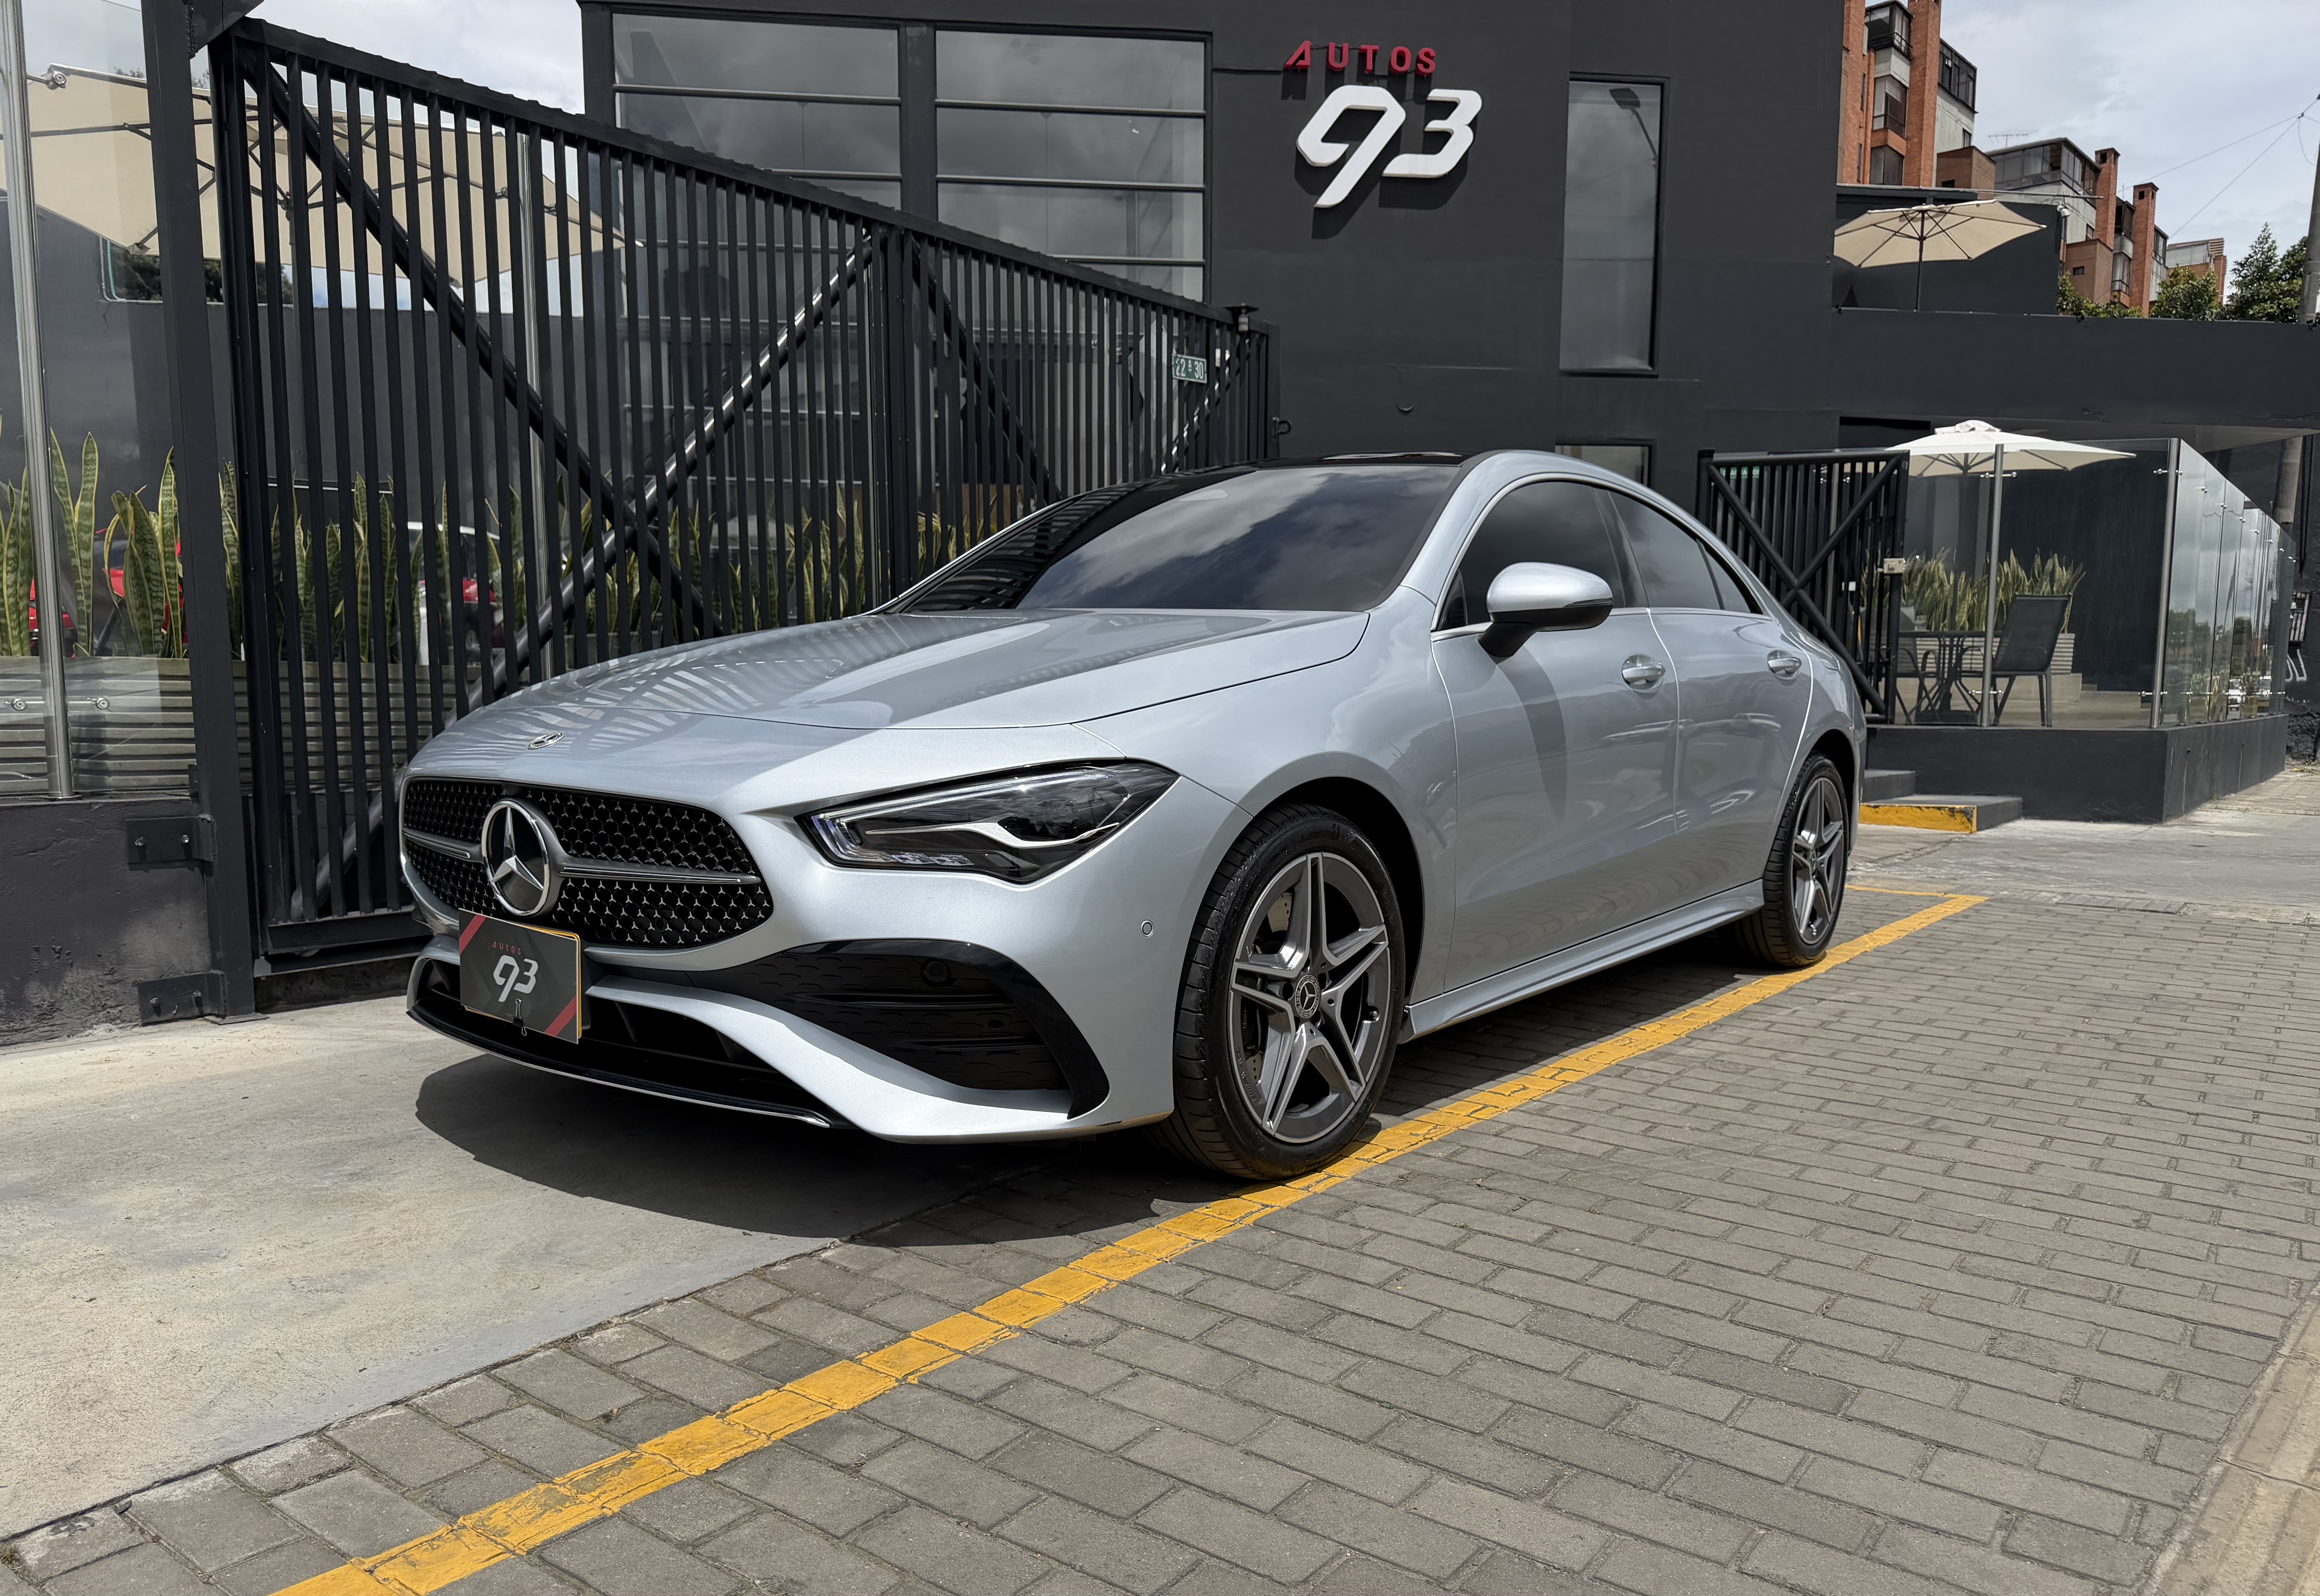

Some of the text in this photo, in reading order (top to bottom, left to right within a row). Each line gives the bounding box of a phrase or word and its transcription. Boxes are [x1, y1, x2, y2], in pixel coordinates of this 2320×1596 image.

[1285, 40, 1436, 76] AUTOS
[1296, 84, 1482, 208] 93
[1195, 361, 1203, 379] 30
[492, 941, 522, 955] AUTOS
[493, 955, 538, 1002] 93
